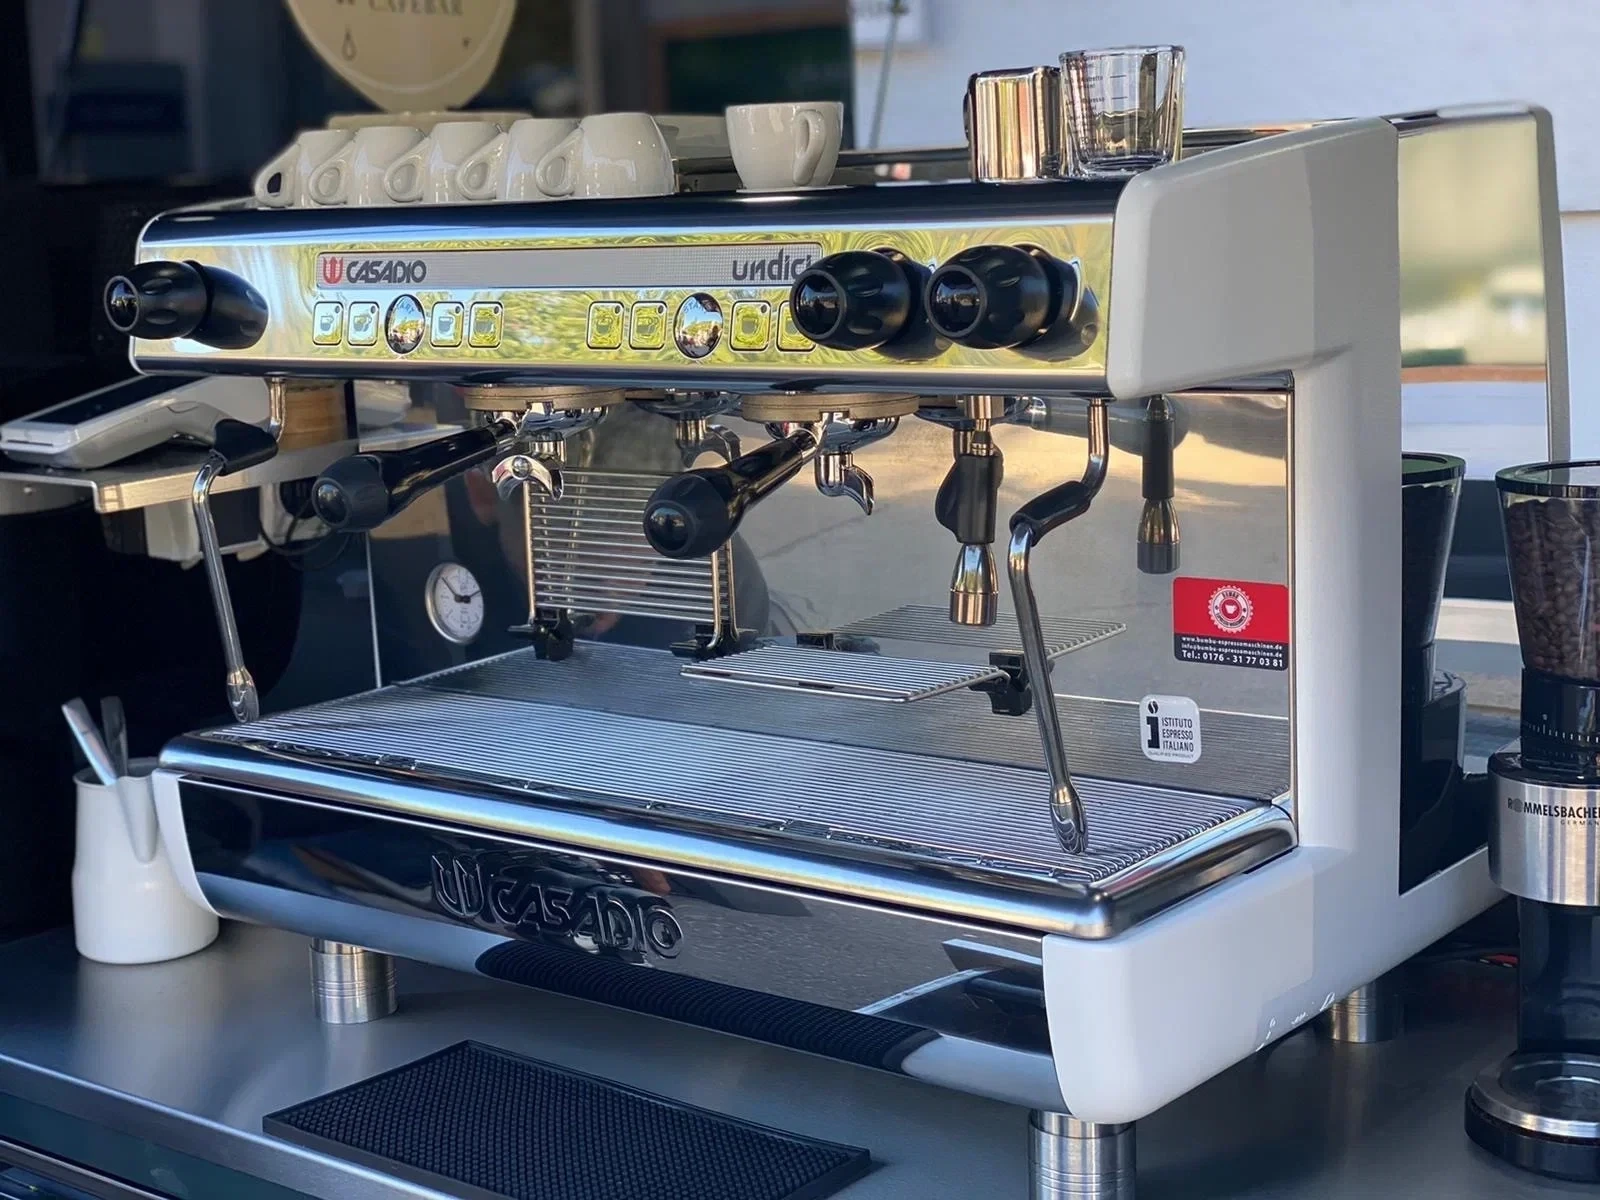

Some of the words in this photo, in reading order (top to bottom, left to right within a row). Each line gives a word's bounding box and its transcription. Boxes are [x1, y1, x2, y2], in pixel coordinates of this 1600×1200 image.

[346, 260, 427, 284] CASADIO
[1182, 650, 1200, 659] Tel.:
[1203, 652, 1224, 662] 0176
[1233, 655, 1243, 664] 31
[1246, 656, 1256, 665] 77
[1259, 658, 1270, 666] 03
[1273, 659, 1283, 667] 81
[1161, 717, 1193, 729] ISTITUTO
[1162, 729, 1194, 741] ESPRESSO
[1163, 740, 1194, 752] ITALIANO
[1508, 798, 1600, 818] ROMMELSBACHE
[489, 878, 684, 960] CASADIO
